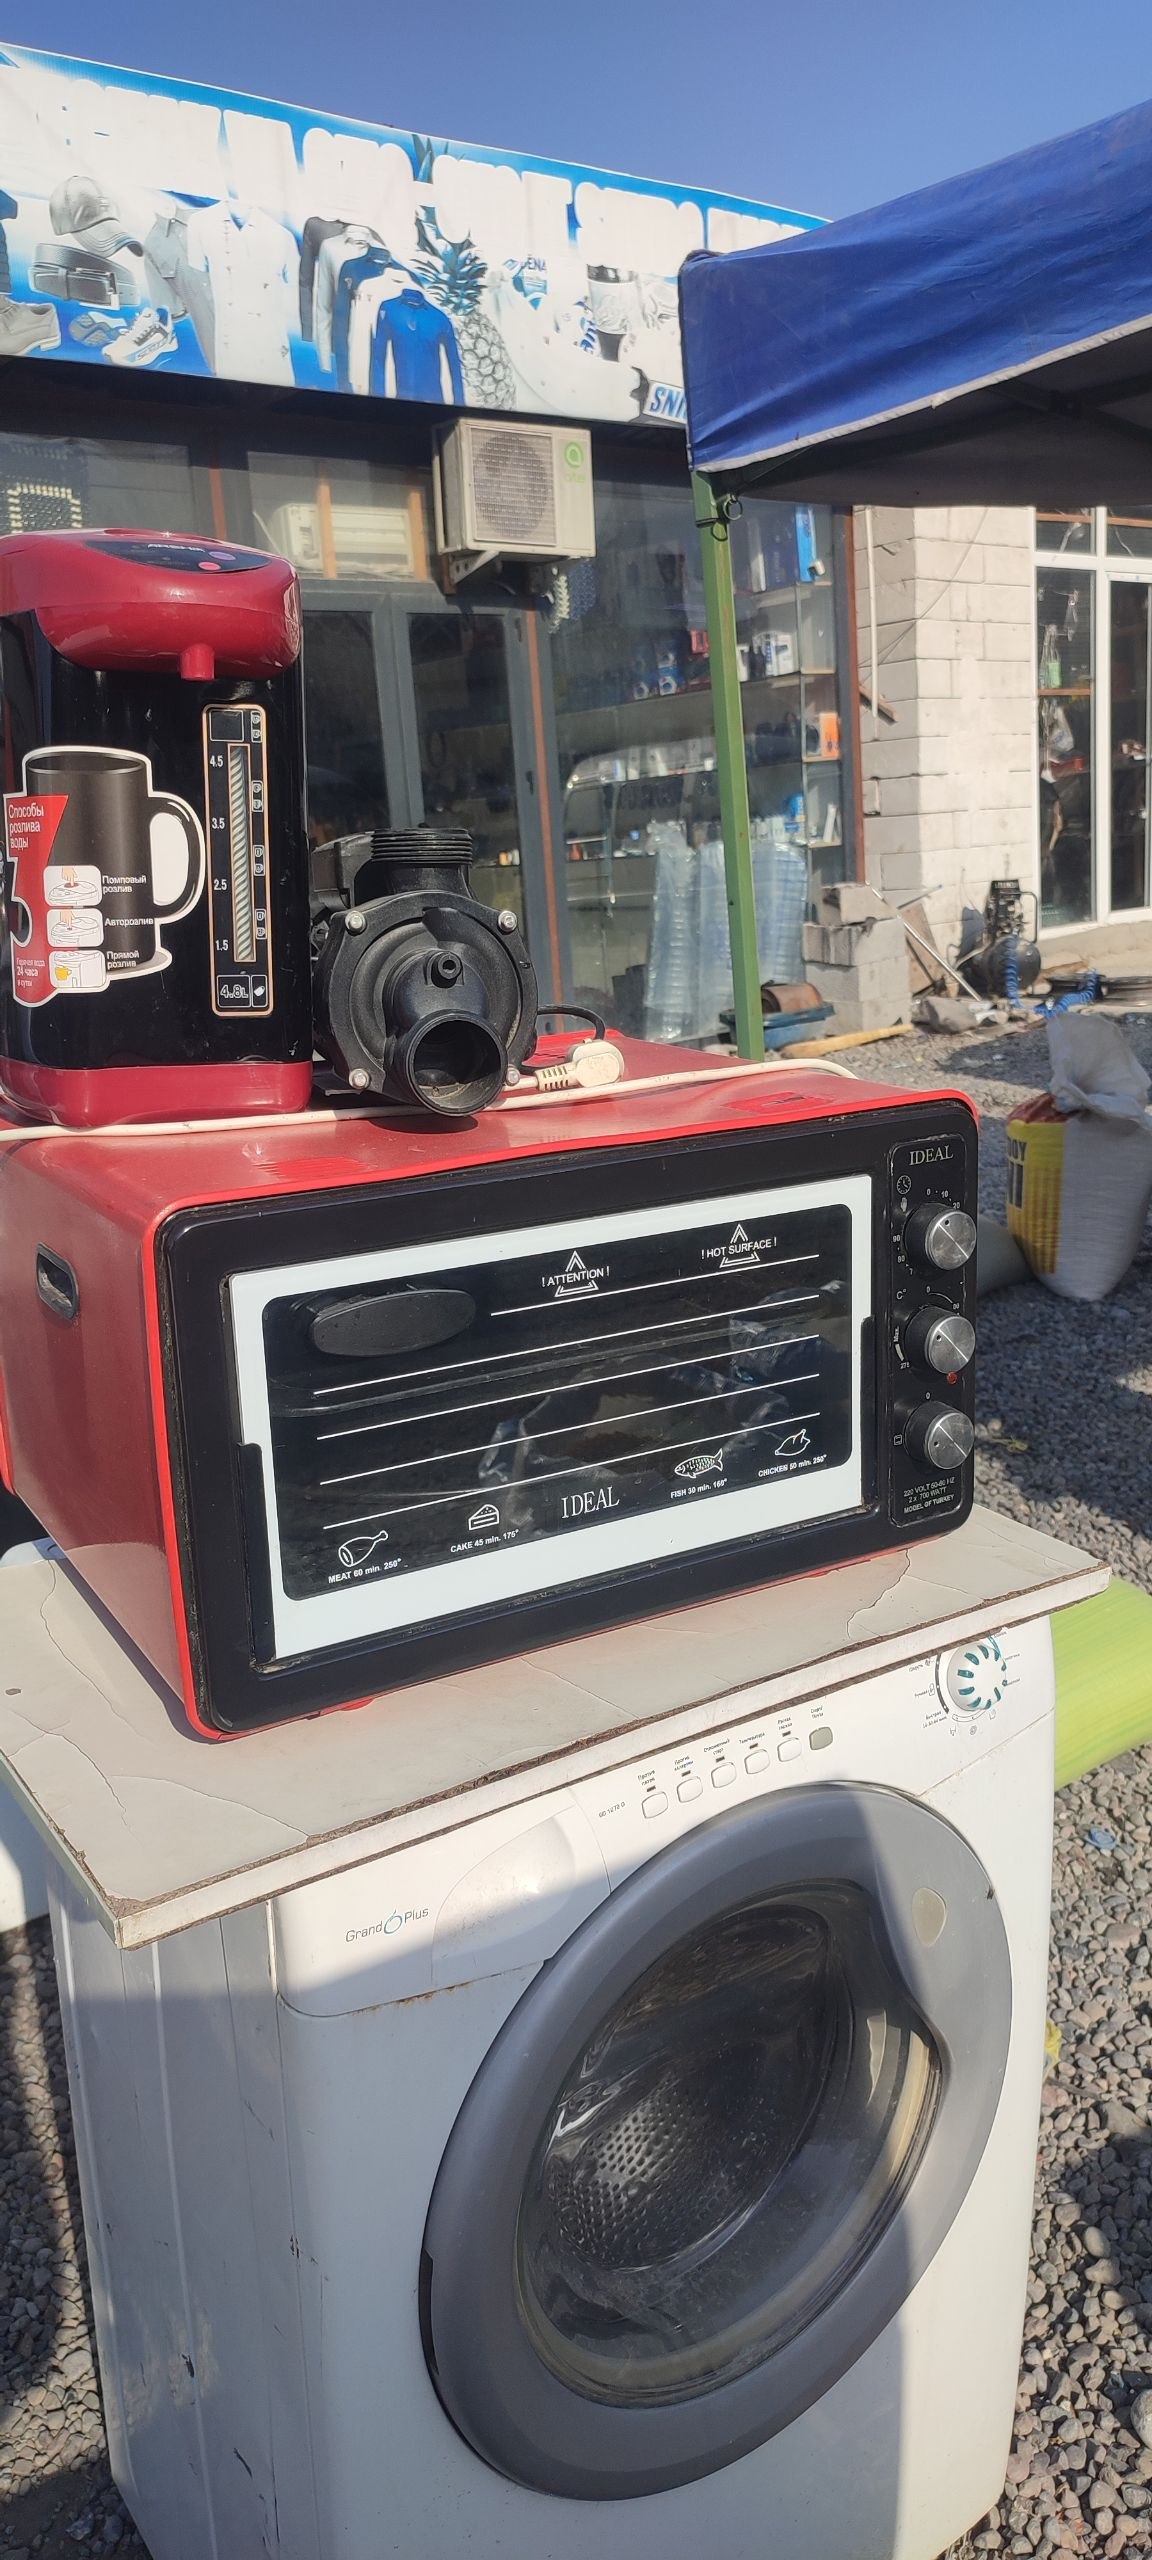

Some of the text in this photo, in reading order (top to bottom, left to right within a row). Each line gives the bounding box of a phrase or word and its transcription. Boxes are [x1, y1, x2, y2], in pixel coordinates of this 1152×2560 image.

[210, 755, 224, 768] 4.5
[8, 802, 45, 819] Способы
[9, 820, 41, 836] розлива
[211, 817, 226, 830] 3.5
[10, 838, 29, 851] воды
[102, 875, 147, 885] Помповый
[213, 878, 228, 892] 2.5
[102, 885, 133, 895] розлив
[104, 917, 154, 928] Авторозлив
[215, 939, 229, 952] 1.5
[106, 950, 140, 961] Прямой
[107, 960, 137, 970] розлив
[220, 984, 249, 999] 4.8L
[908, 1145, 954, 1166] IDEAL
[941, 1190, 949, 1199] 10
[706, 1246, 727, 1259] HOT
[728, 1238, 772, 1255] SURFACE
[546, 1267, 605, 1287] ATTENTION
[670, 1489, 687, 1499] FISH
[687, 1486, 697, 1495] 30
[560, 1486, 620, 1519] IDEAL
[450, 1541, 474, 1553] CAKE
[474, 1538, 484, 1547] 45
[328, 1571, 352, 1584] MEAT
[353, 1568, 364, 1578] 60
[345, 1921, 383, 1943] Grand
[404, 1908, 429, 1923] Plus
